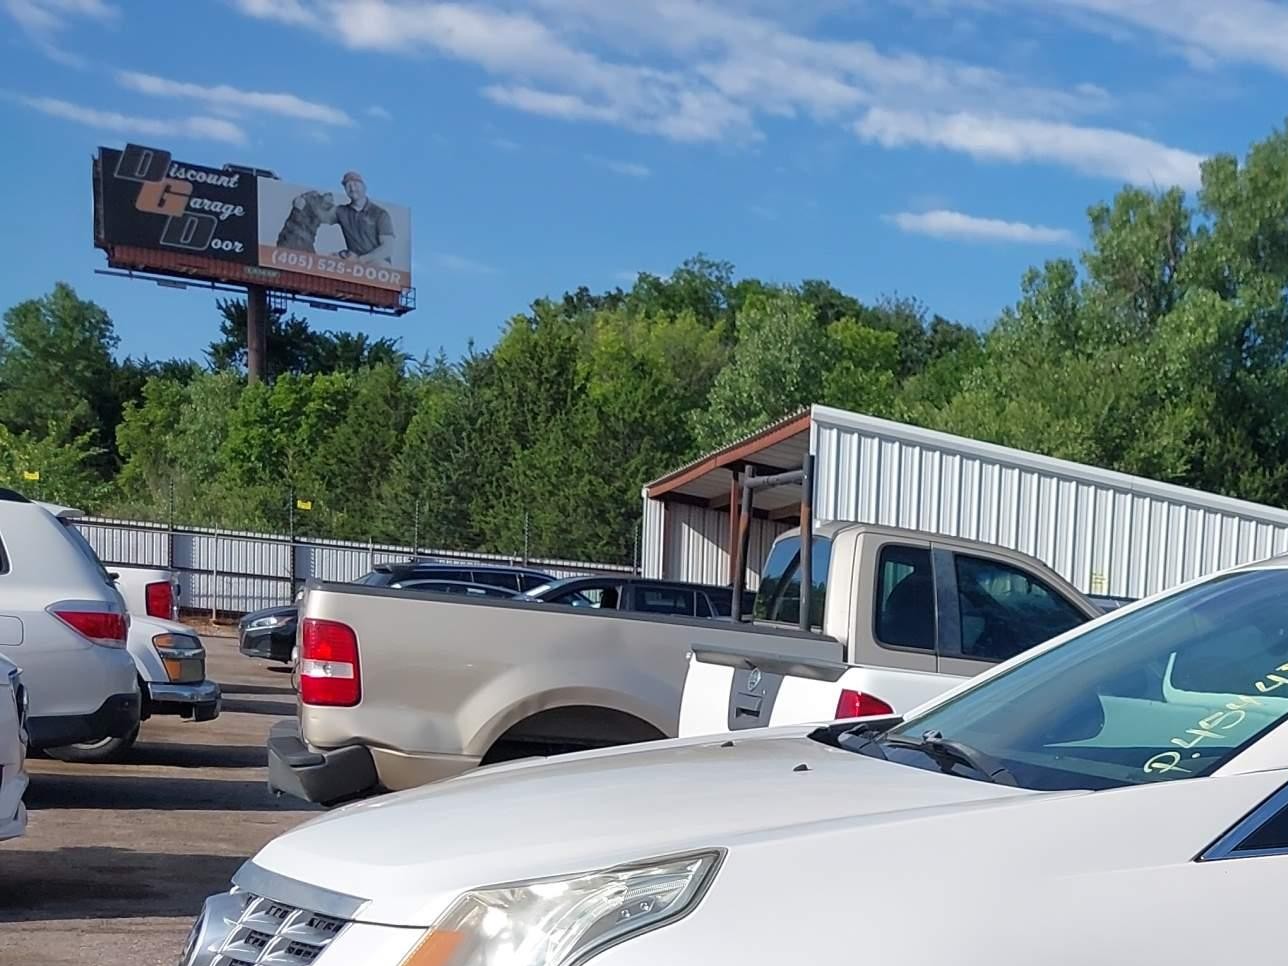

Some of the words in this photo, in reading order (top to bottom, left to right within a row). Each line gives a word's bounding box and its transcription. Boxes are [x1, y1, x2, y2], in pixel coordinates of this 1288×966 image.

[114, 143, 239, 188] Discount
[135, 178, 245, 220] Garage
[160, 211, 244, 253] Door
[271, 250, 312, 270] (405)
[318, 258, 401, 284] 525-DOOR
